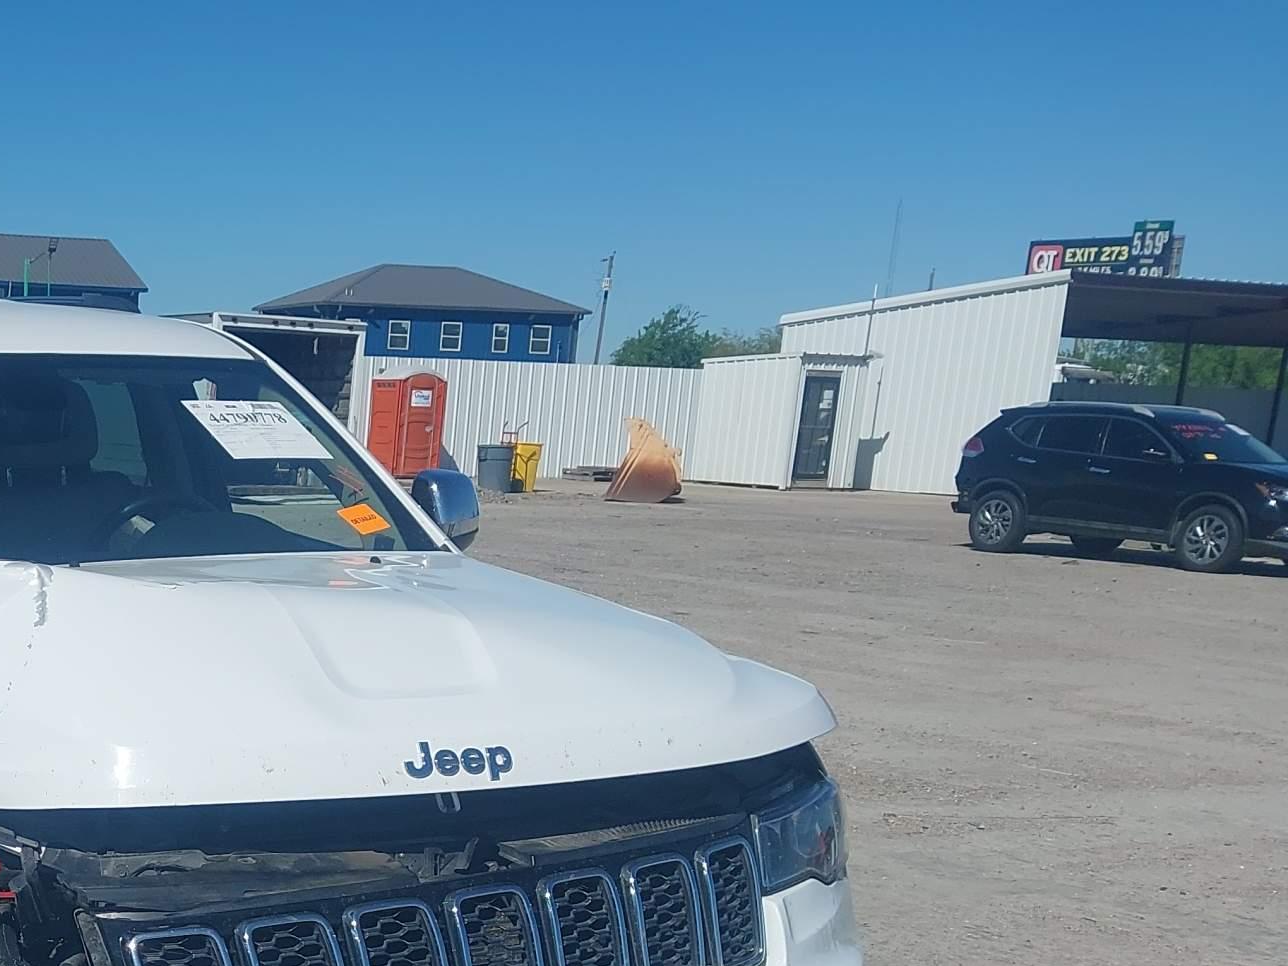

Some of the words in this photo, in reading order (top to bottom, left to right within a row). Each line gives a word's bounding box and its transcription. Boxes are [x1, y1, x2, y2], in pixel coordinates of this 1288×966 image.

[1033, 250, 1057, 272] QT
[1065, 248, 1098, 262] EXIT
[1100, 246, 1128, 261] 273
[404, 741, 512, 781] Jeep
